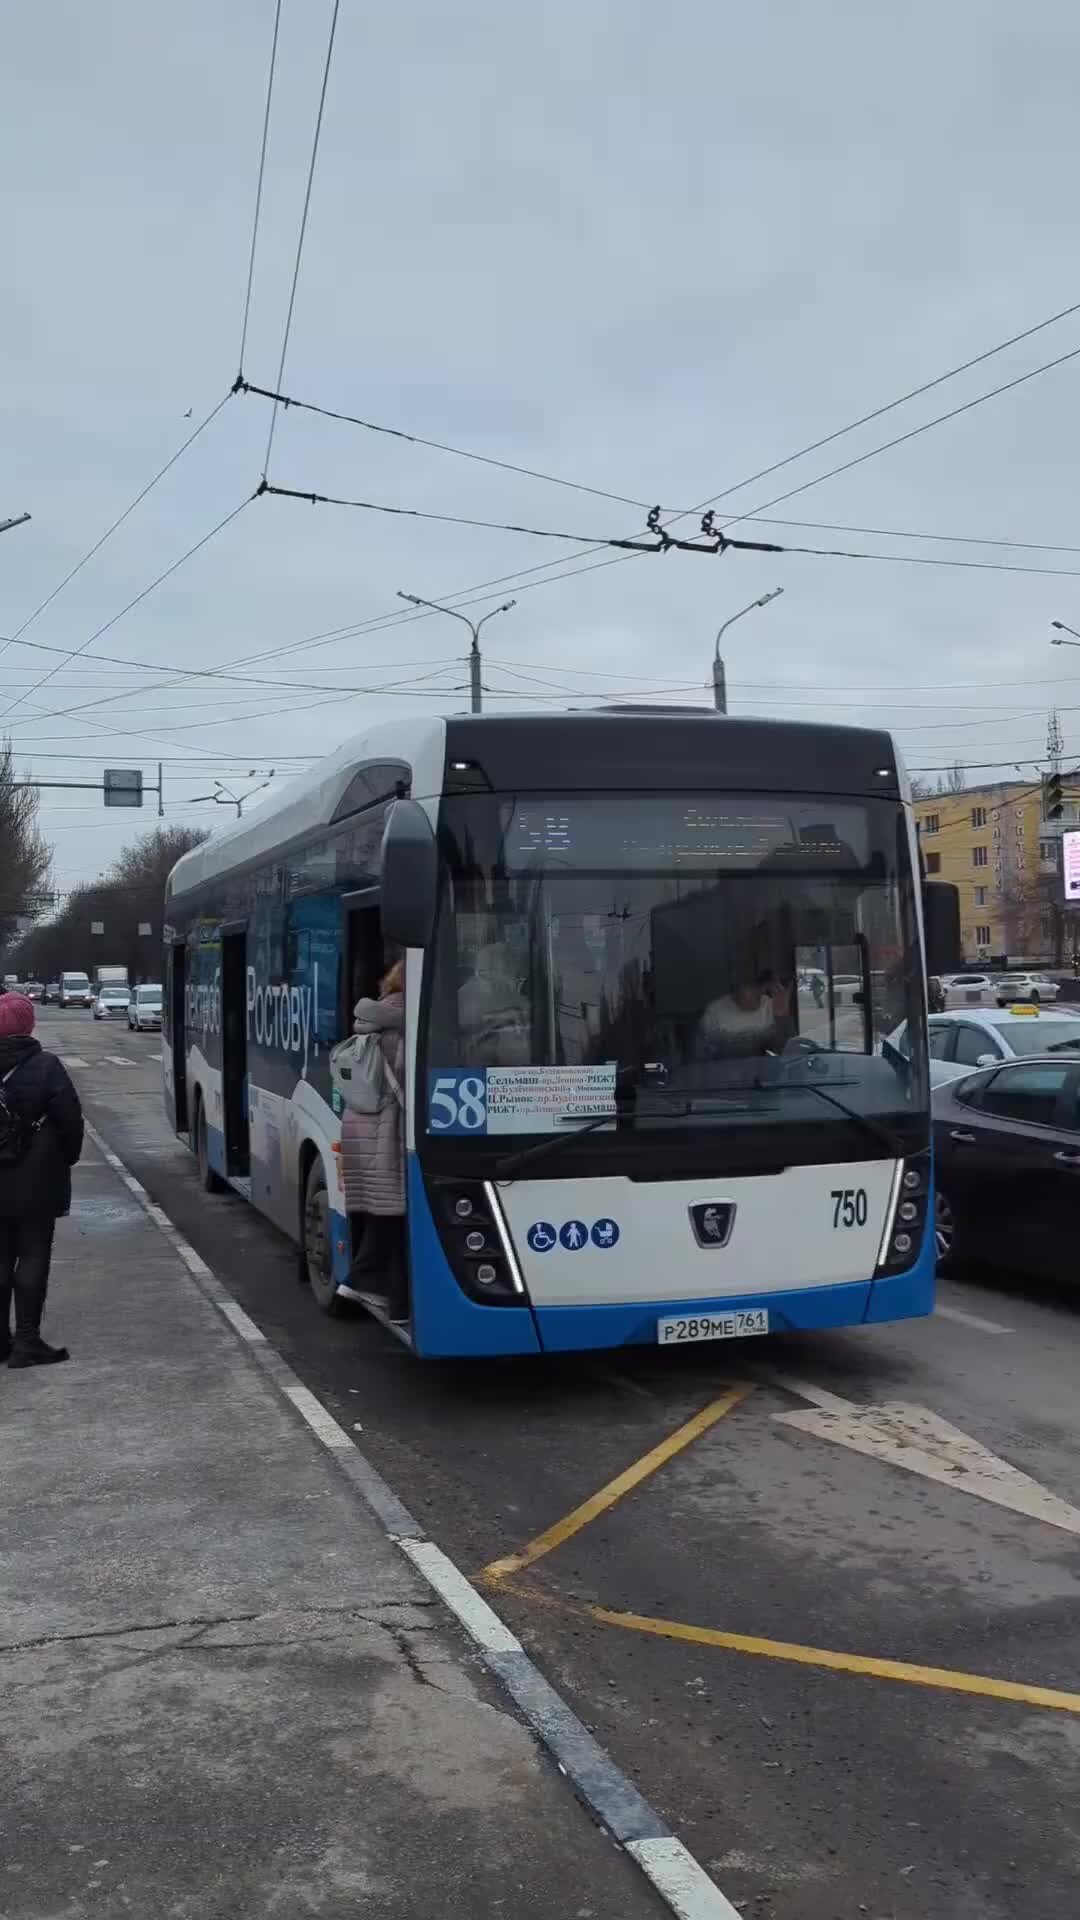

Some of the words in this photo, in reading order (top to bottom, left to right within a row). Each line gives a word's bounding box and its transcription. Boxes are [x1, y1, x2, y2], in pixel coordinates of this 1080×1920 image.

[246, 962, 318, 1080] Ростову!
[431, 1077, 486, 1129] 58
[830, 1188, 867, 1229] 750
